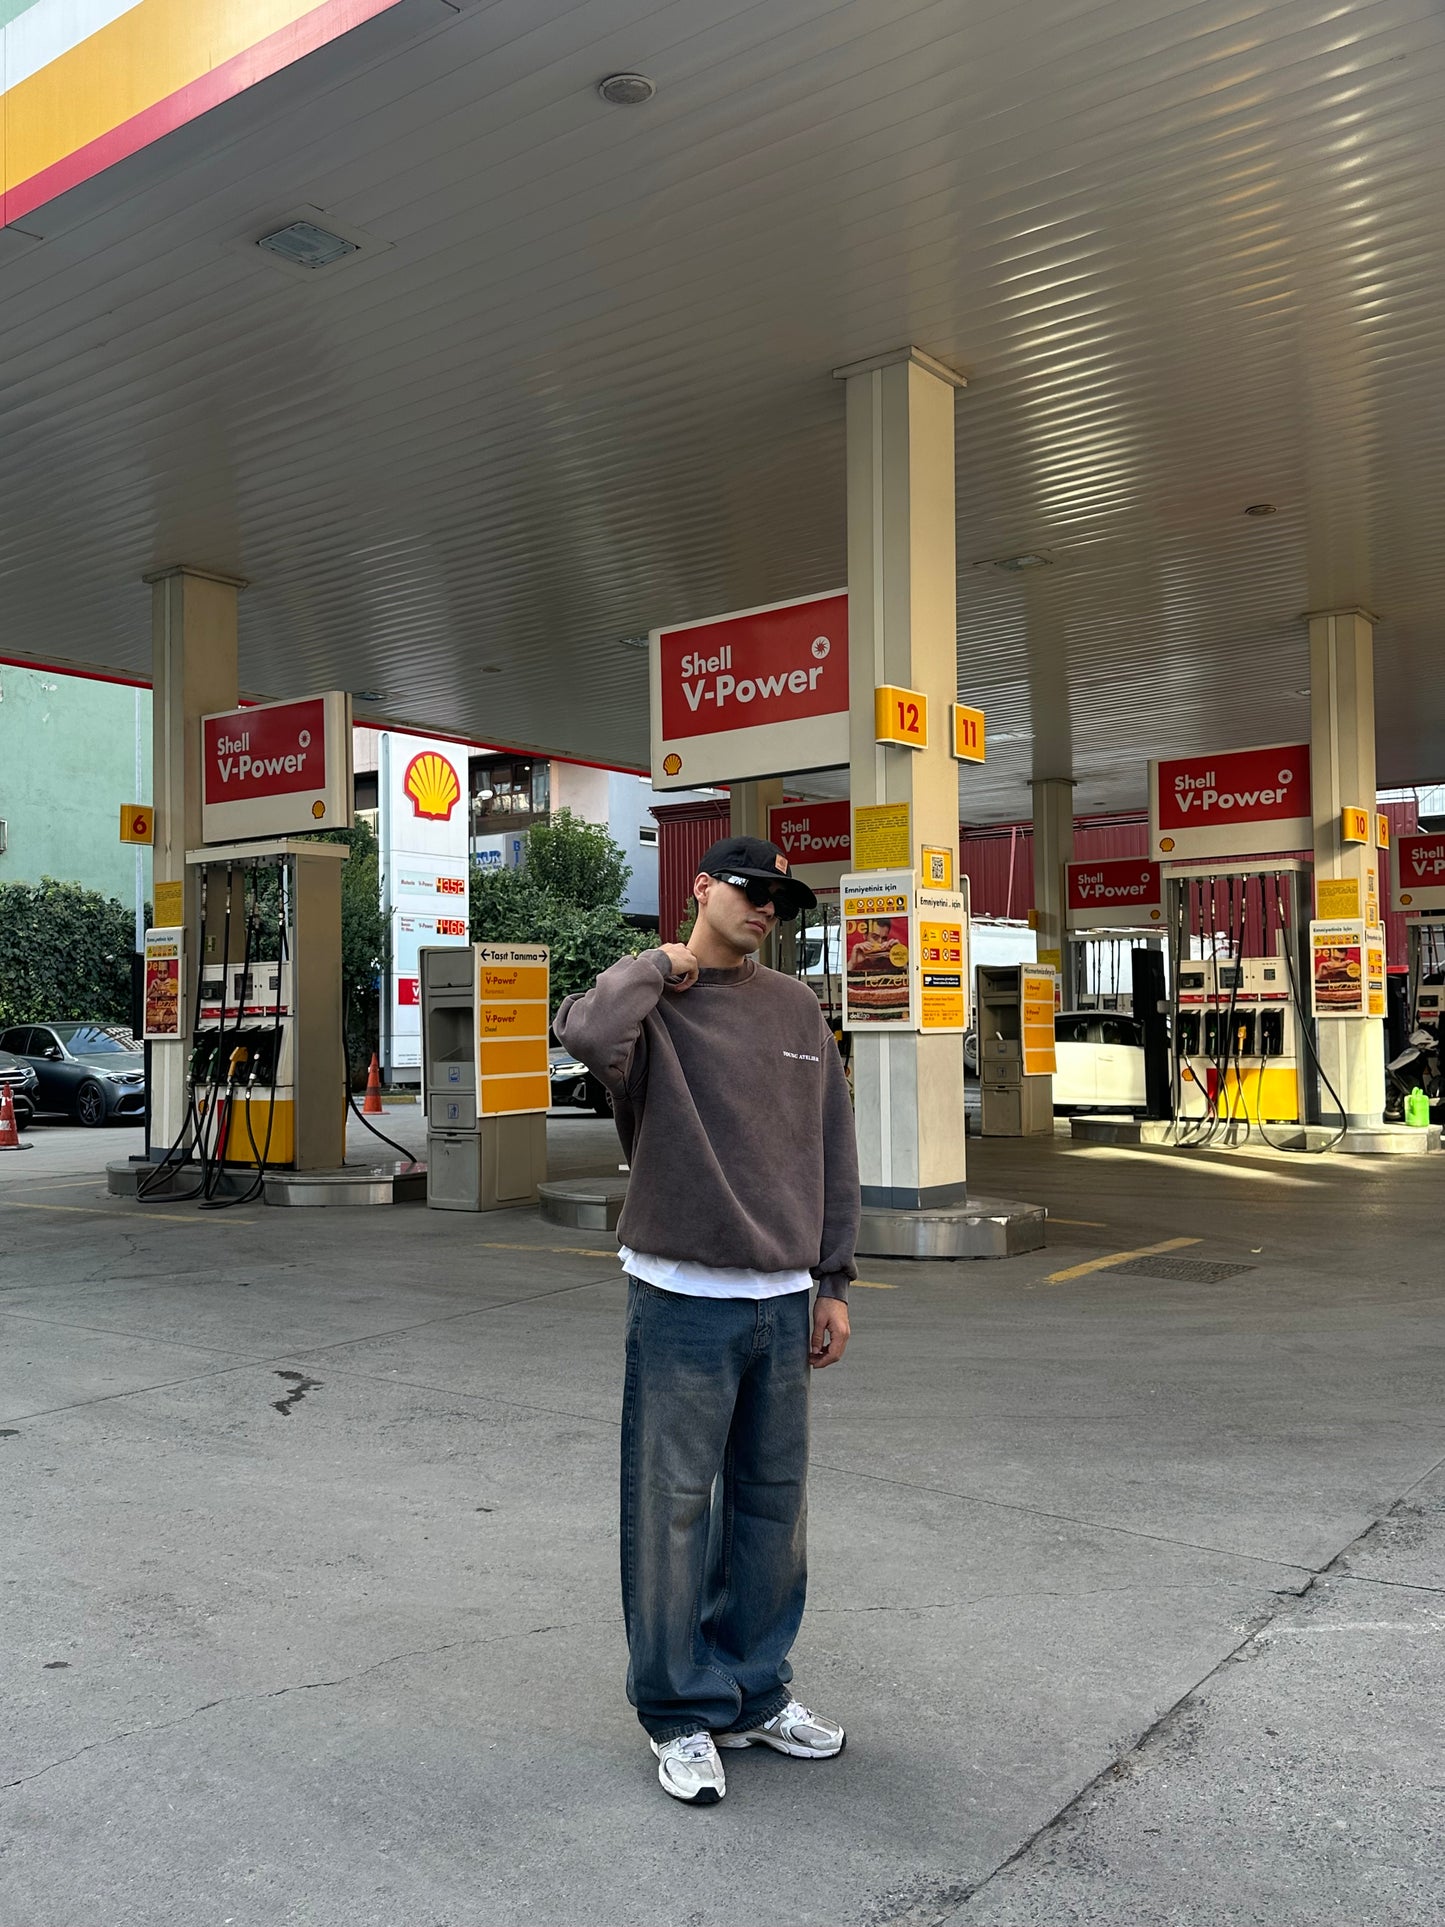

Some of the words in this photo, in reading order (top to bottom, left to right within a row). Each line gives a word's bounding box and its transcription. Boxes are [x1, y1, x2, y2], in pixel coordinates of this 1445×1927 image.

[681, 645, 732, 678] Shell
[681, 666, 823, 712] V-Power
[897, 701, 919, 733] 12
[963, 718, 976, 748] 11
[217, 732, 250, 756] Shell
[217, 753, 307, 783] V-Power
[1174, 771, 1215, 791] Shell
[1174, 788, 1287, 813] V-Power
[132, 814, 147, 835] 6
[781, 818, 810, 834] Shell
[1356, 816, 1366, 835] 10
[1381, 823, 1387, 841] 9
[781, 834, 850, 853] V-Powe
[1411, 846, 1445, 860] Shell
[1078, 872, 1103, 885] Shell
[844, 885, 883, 894] Emniyetiniz
[885, 883, 897, 893] için
[1078, 884, 1147, 899] V-Power
[491, 951, 508, 962] Taşıt
[510, 952, 538, 961] Tanıma
[485, 976, 516, 985] V-Power
[485, 1014, 516, 1023] V-Power
